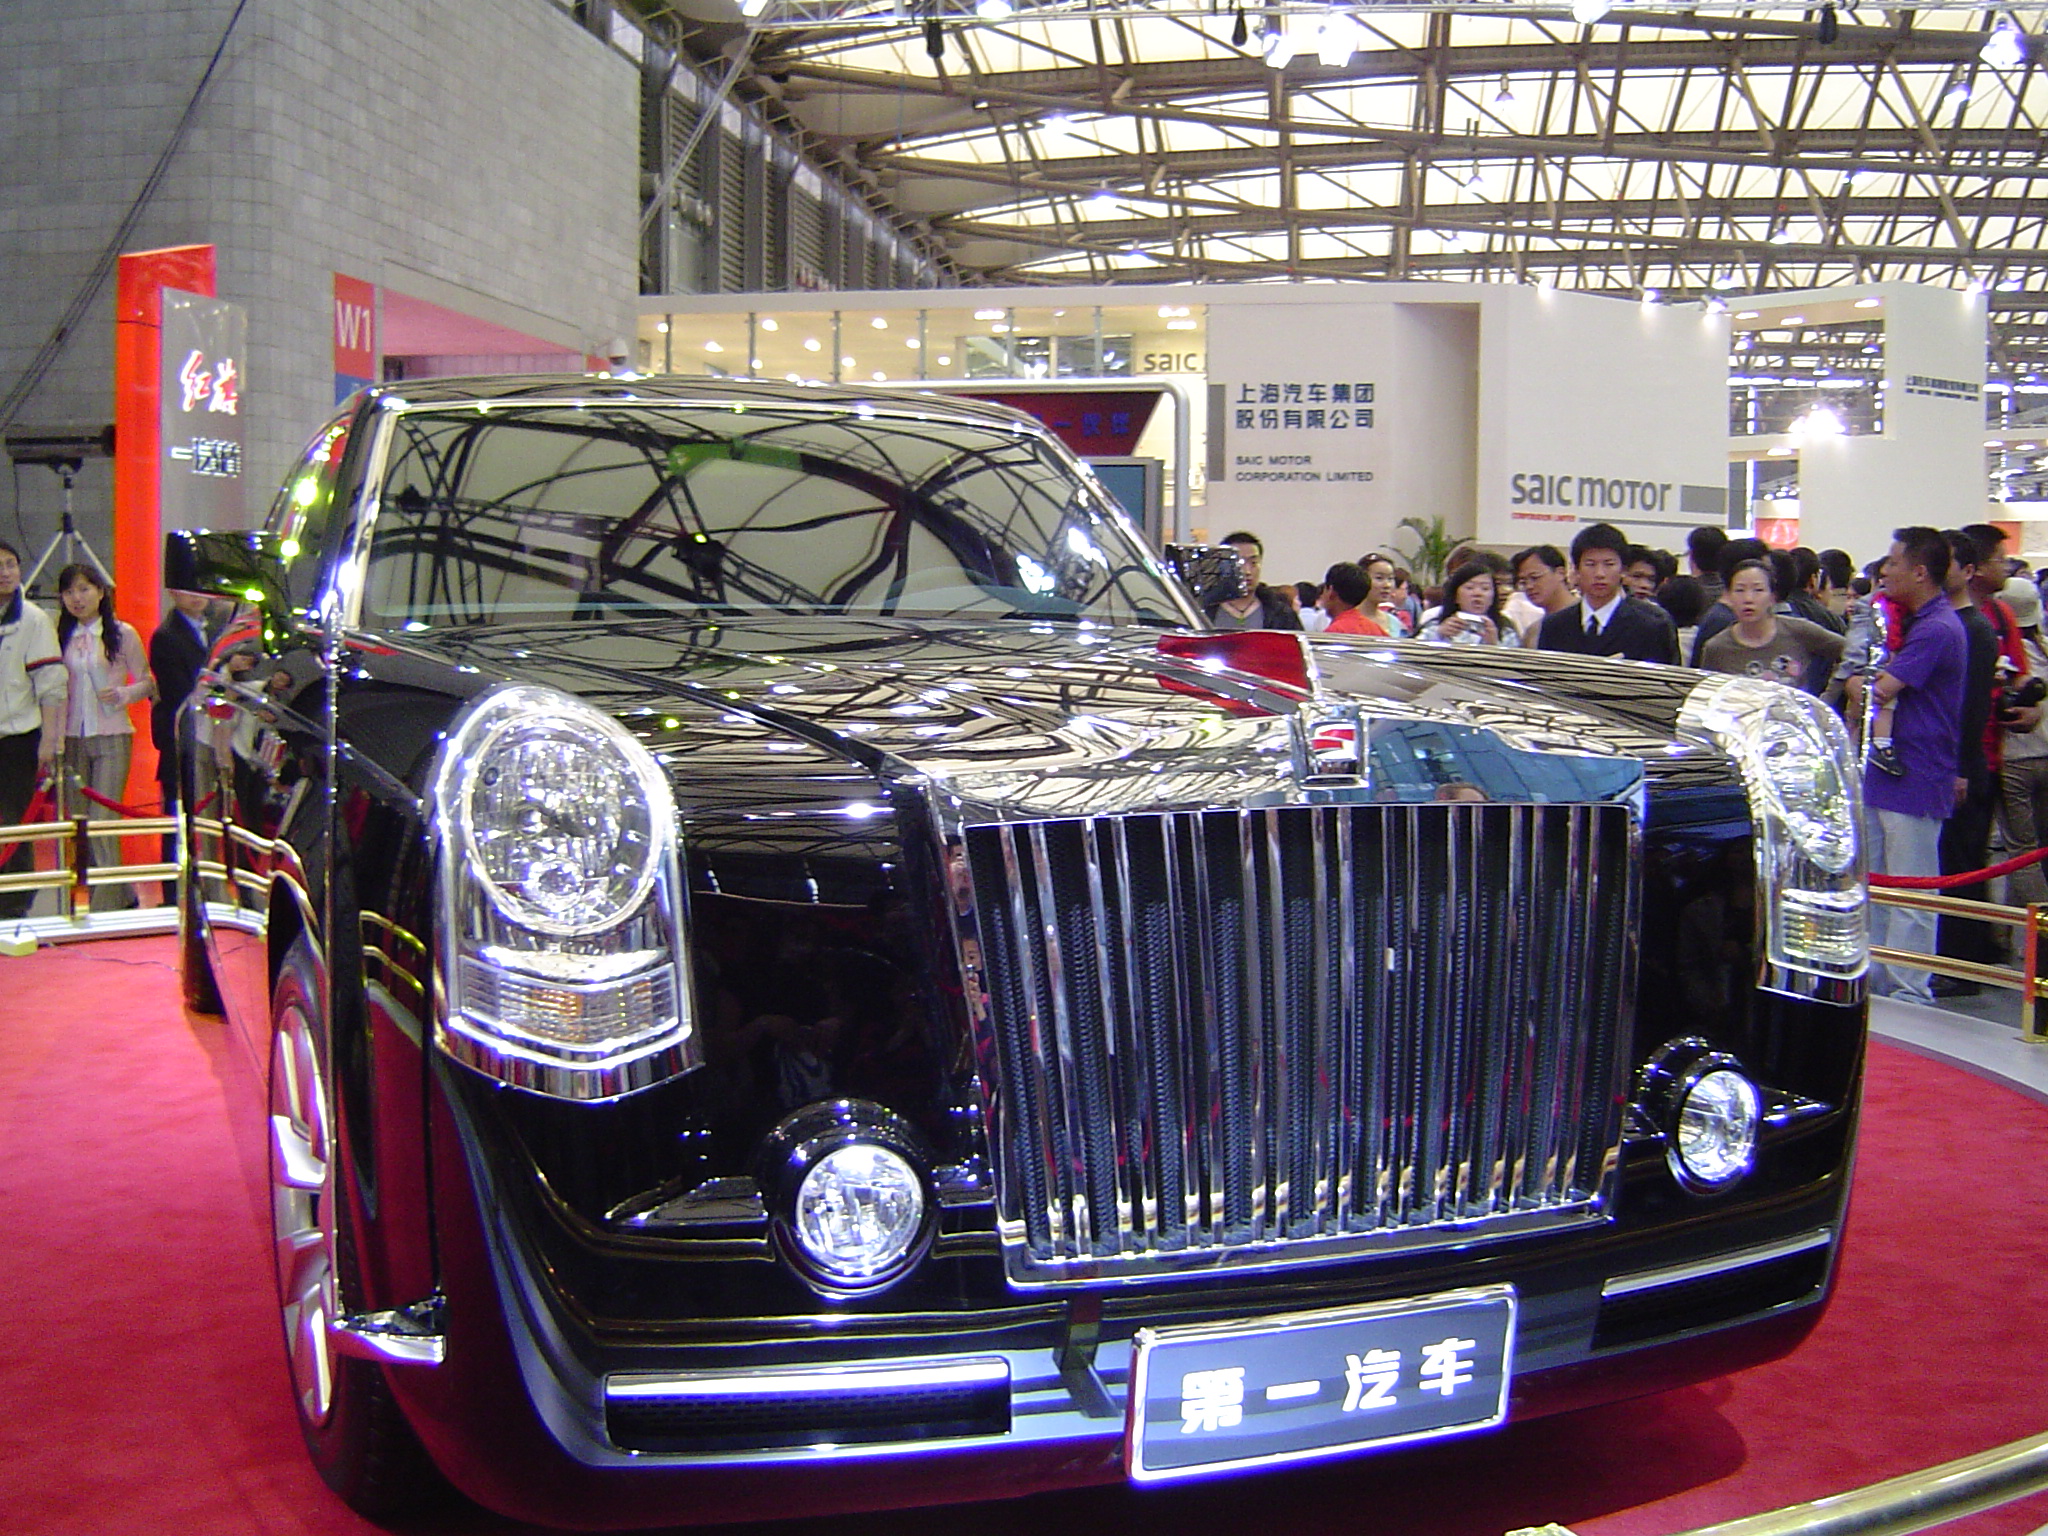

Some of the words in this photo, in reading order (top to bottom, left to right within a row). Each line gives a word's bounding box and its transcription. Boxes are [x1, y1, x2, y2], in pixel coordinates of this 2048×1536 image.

[336, 299, 371, 353] W1
[1144, 353, 1198, 372] saic
[1236, 383, 1375, 404] 上海汽车集团
[1236, 409, 1375, 430] 股份有限公司
[1236, 455, 1263, 466] SAIC
[1269, 455, 1312, 466] MOTOR
[1236, 471, 1321, 483] CORPORATION
[1327, 471, 1374, 482] LIMITED
[1511, 473, 1573, 506] saic
[1180, 1337, 1476, 1434] 第一汽车
